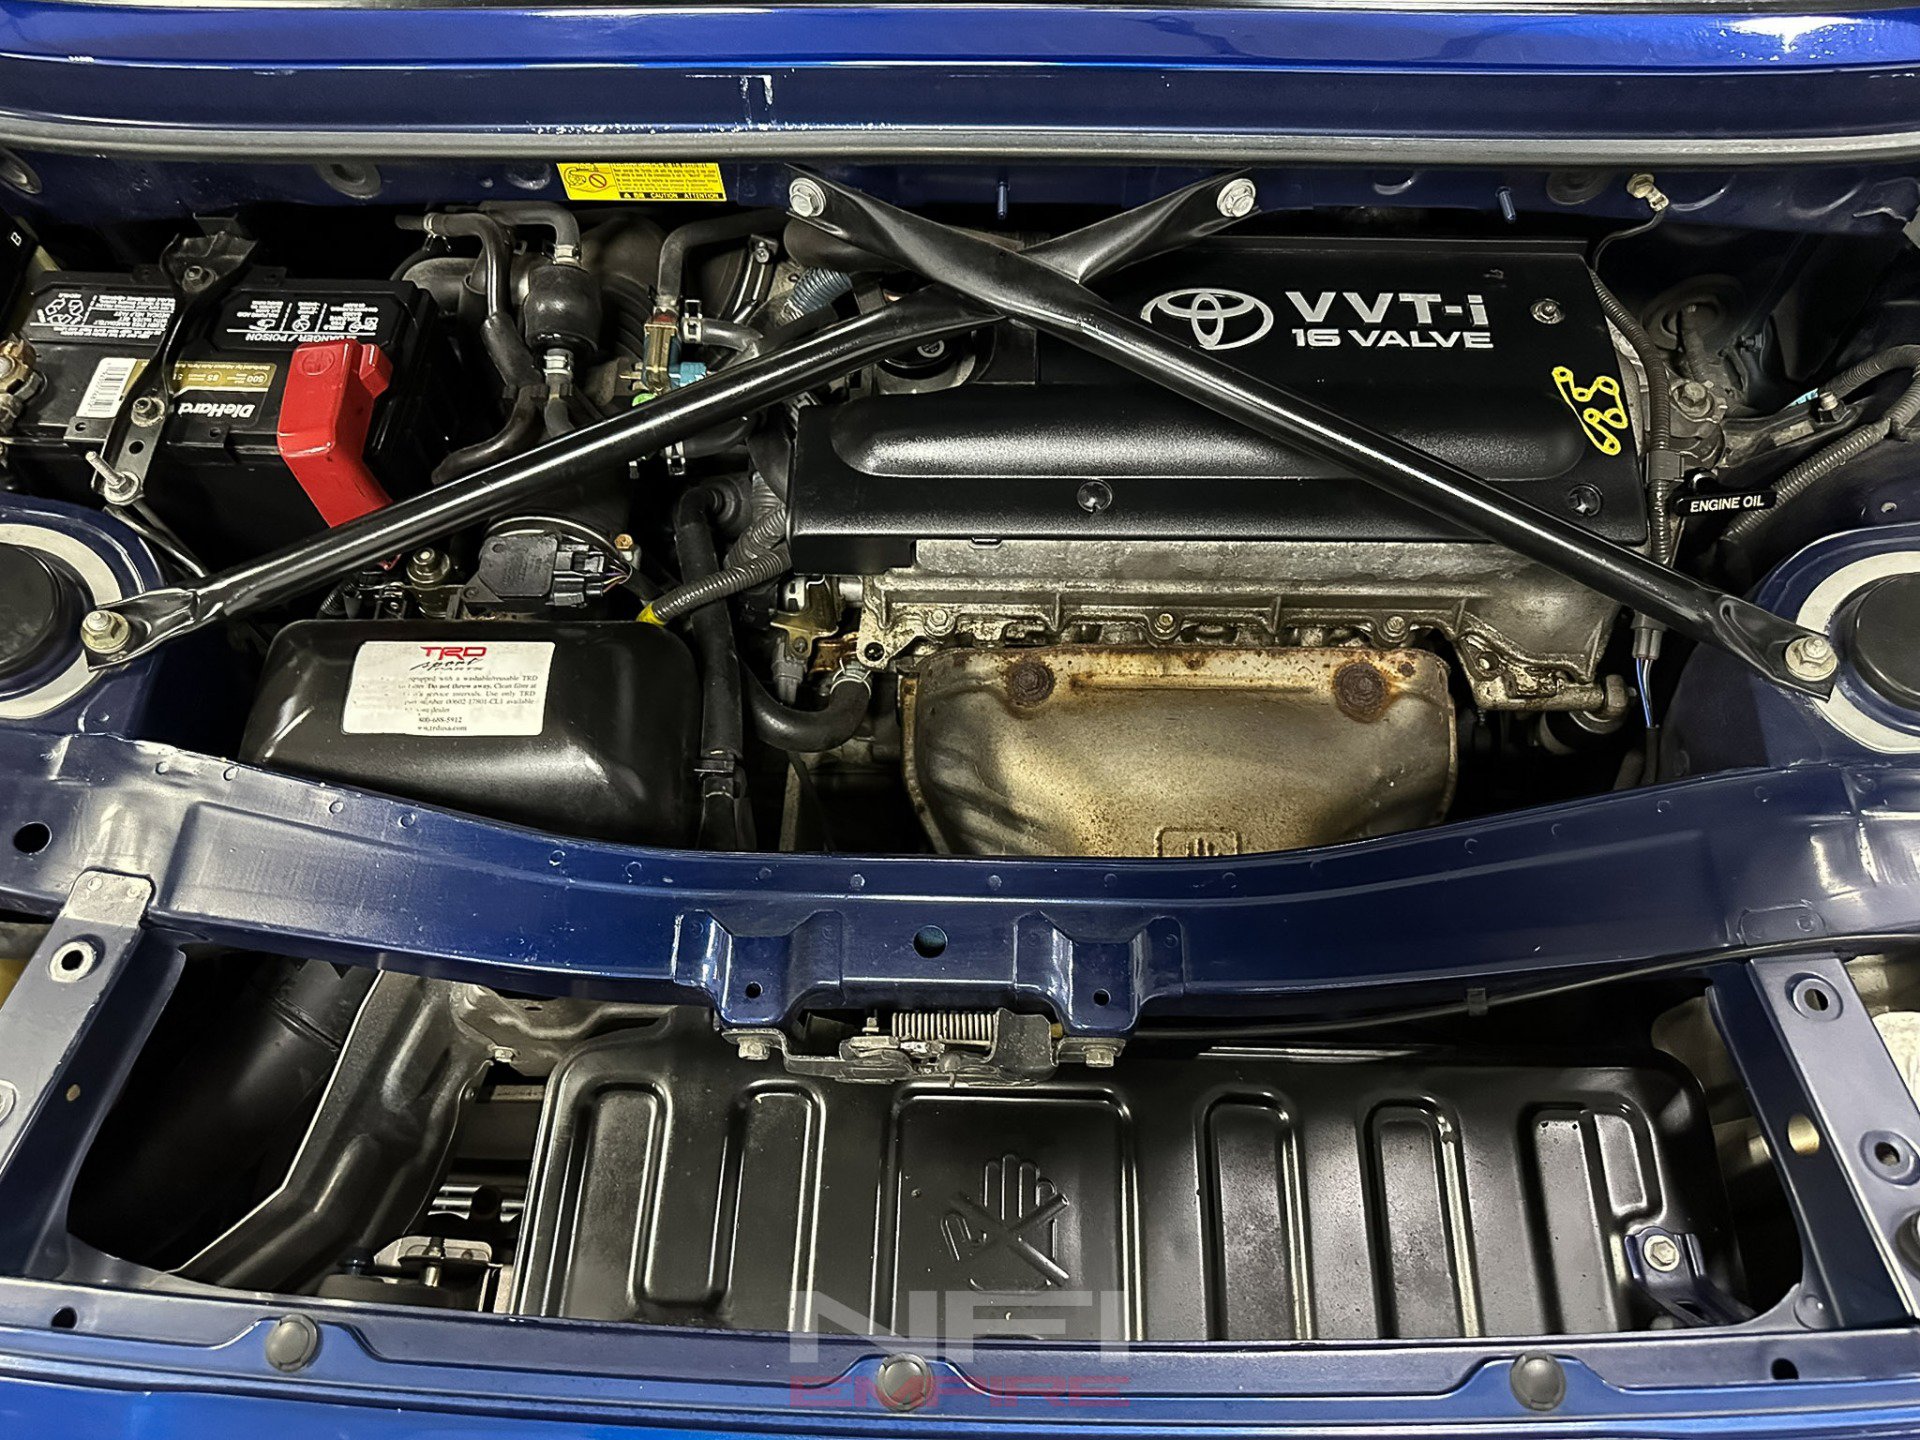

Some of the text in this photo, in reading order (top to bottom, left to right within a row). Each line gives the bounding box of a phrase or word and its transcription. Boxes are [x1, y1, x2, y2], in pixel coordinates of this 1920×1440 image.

[1285, 291, 1490, 327] VVT-i
[245, 333, 288, 342] POISON
[1291, 328, 1495, 349] 16 VALVE
[207, 374, 219, 382] 85
[246, 375, 265, 383] 500
[177, 402, 256, 418] DieHard
[1690, 494, 1765, 513] ENGINE OIL
[420, 646, 487, 661] TRD
